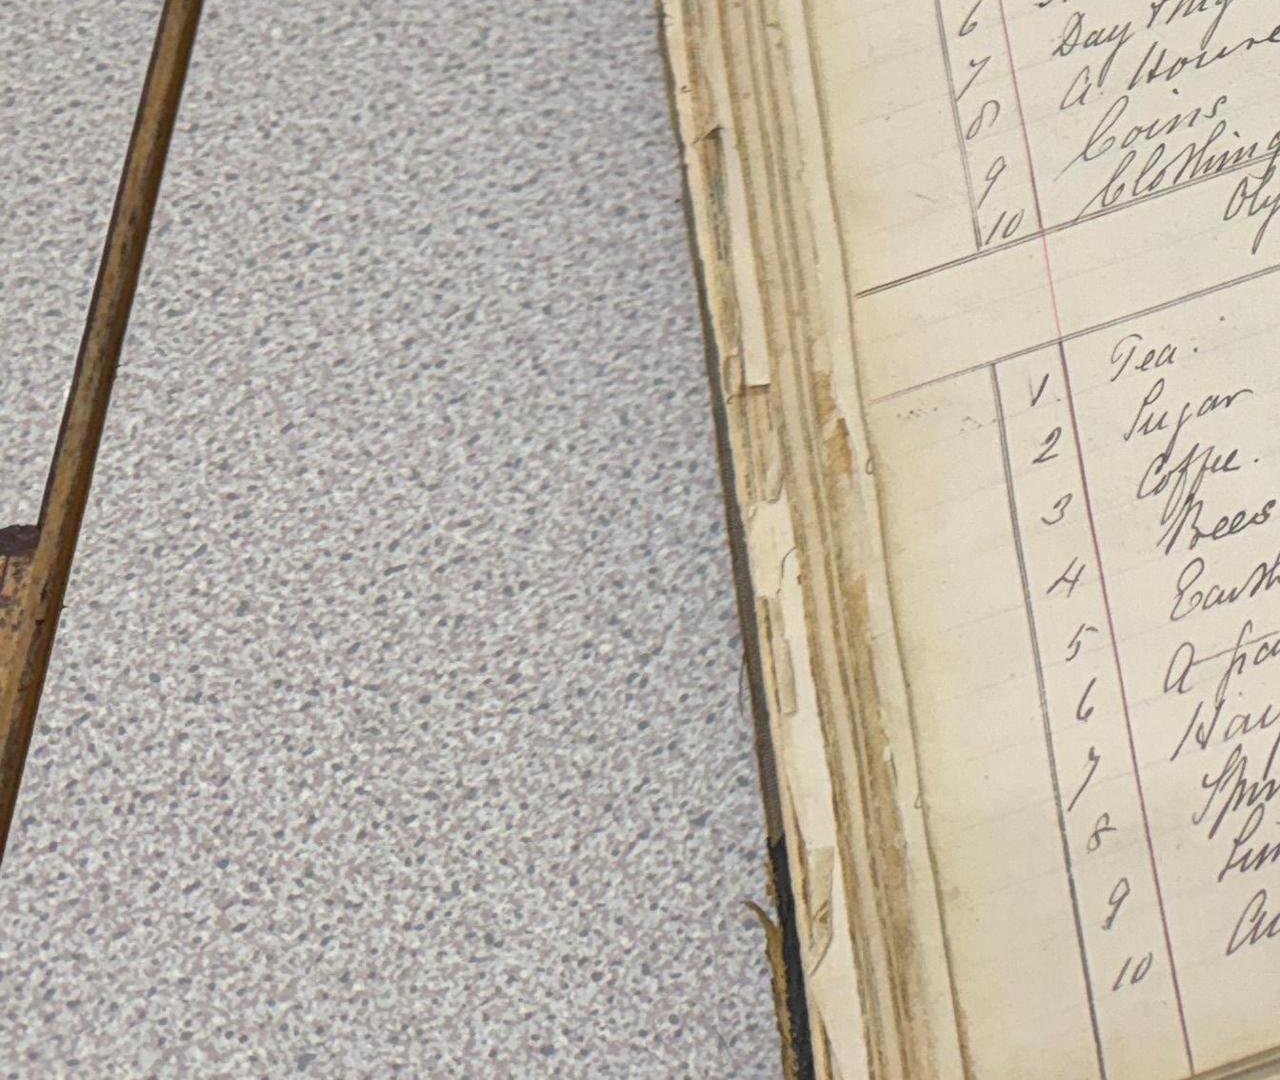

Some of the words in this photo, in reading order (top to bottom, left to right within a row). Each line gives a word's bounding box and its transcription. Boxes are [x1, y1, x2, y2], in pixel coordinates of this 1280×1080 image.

[957, 0, 984, 38] 6
[955, 55, 993, 102] 7
[1050, 11, 1137, 90] Day
[965, 99, 1002, 141] 8
[977, 155, 1007, 209] 9
[1054, 94, 1229, 182] Coins
[984, 207, 1027, 246] 10
[1030, 373, 1050, 408] 1
[1031, 426, 1062, 464] 2
[1123, 377, 1256, 466] Sugar
[1040, 492, 1074, 527] 3
[1136, 441, 1243, 526] Coffee
[1045, 556, 1085, 600] 4
[1064, 623, 1099, 662] 5
[1075, 677, 1097, 723] 6
[1067, 746, 1102, 812] 7
[1086, 811, 1119, 853] 8
[1100, 876, 1131, 931] 9
[1111, 951, 1154, 993] 10
